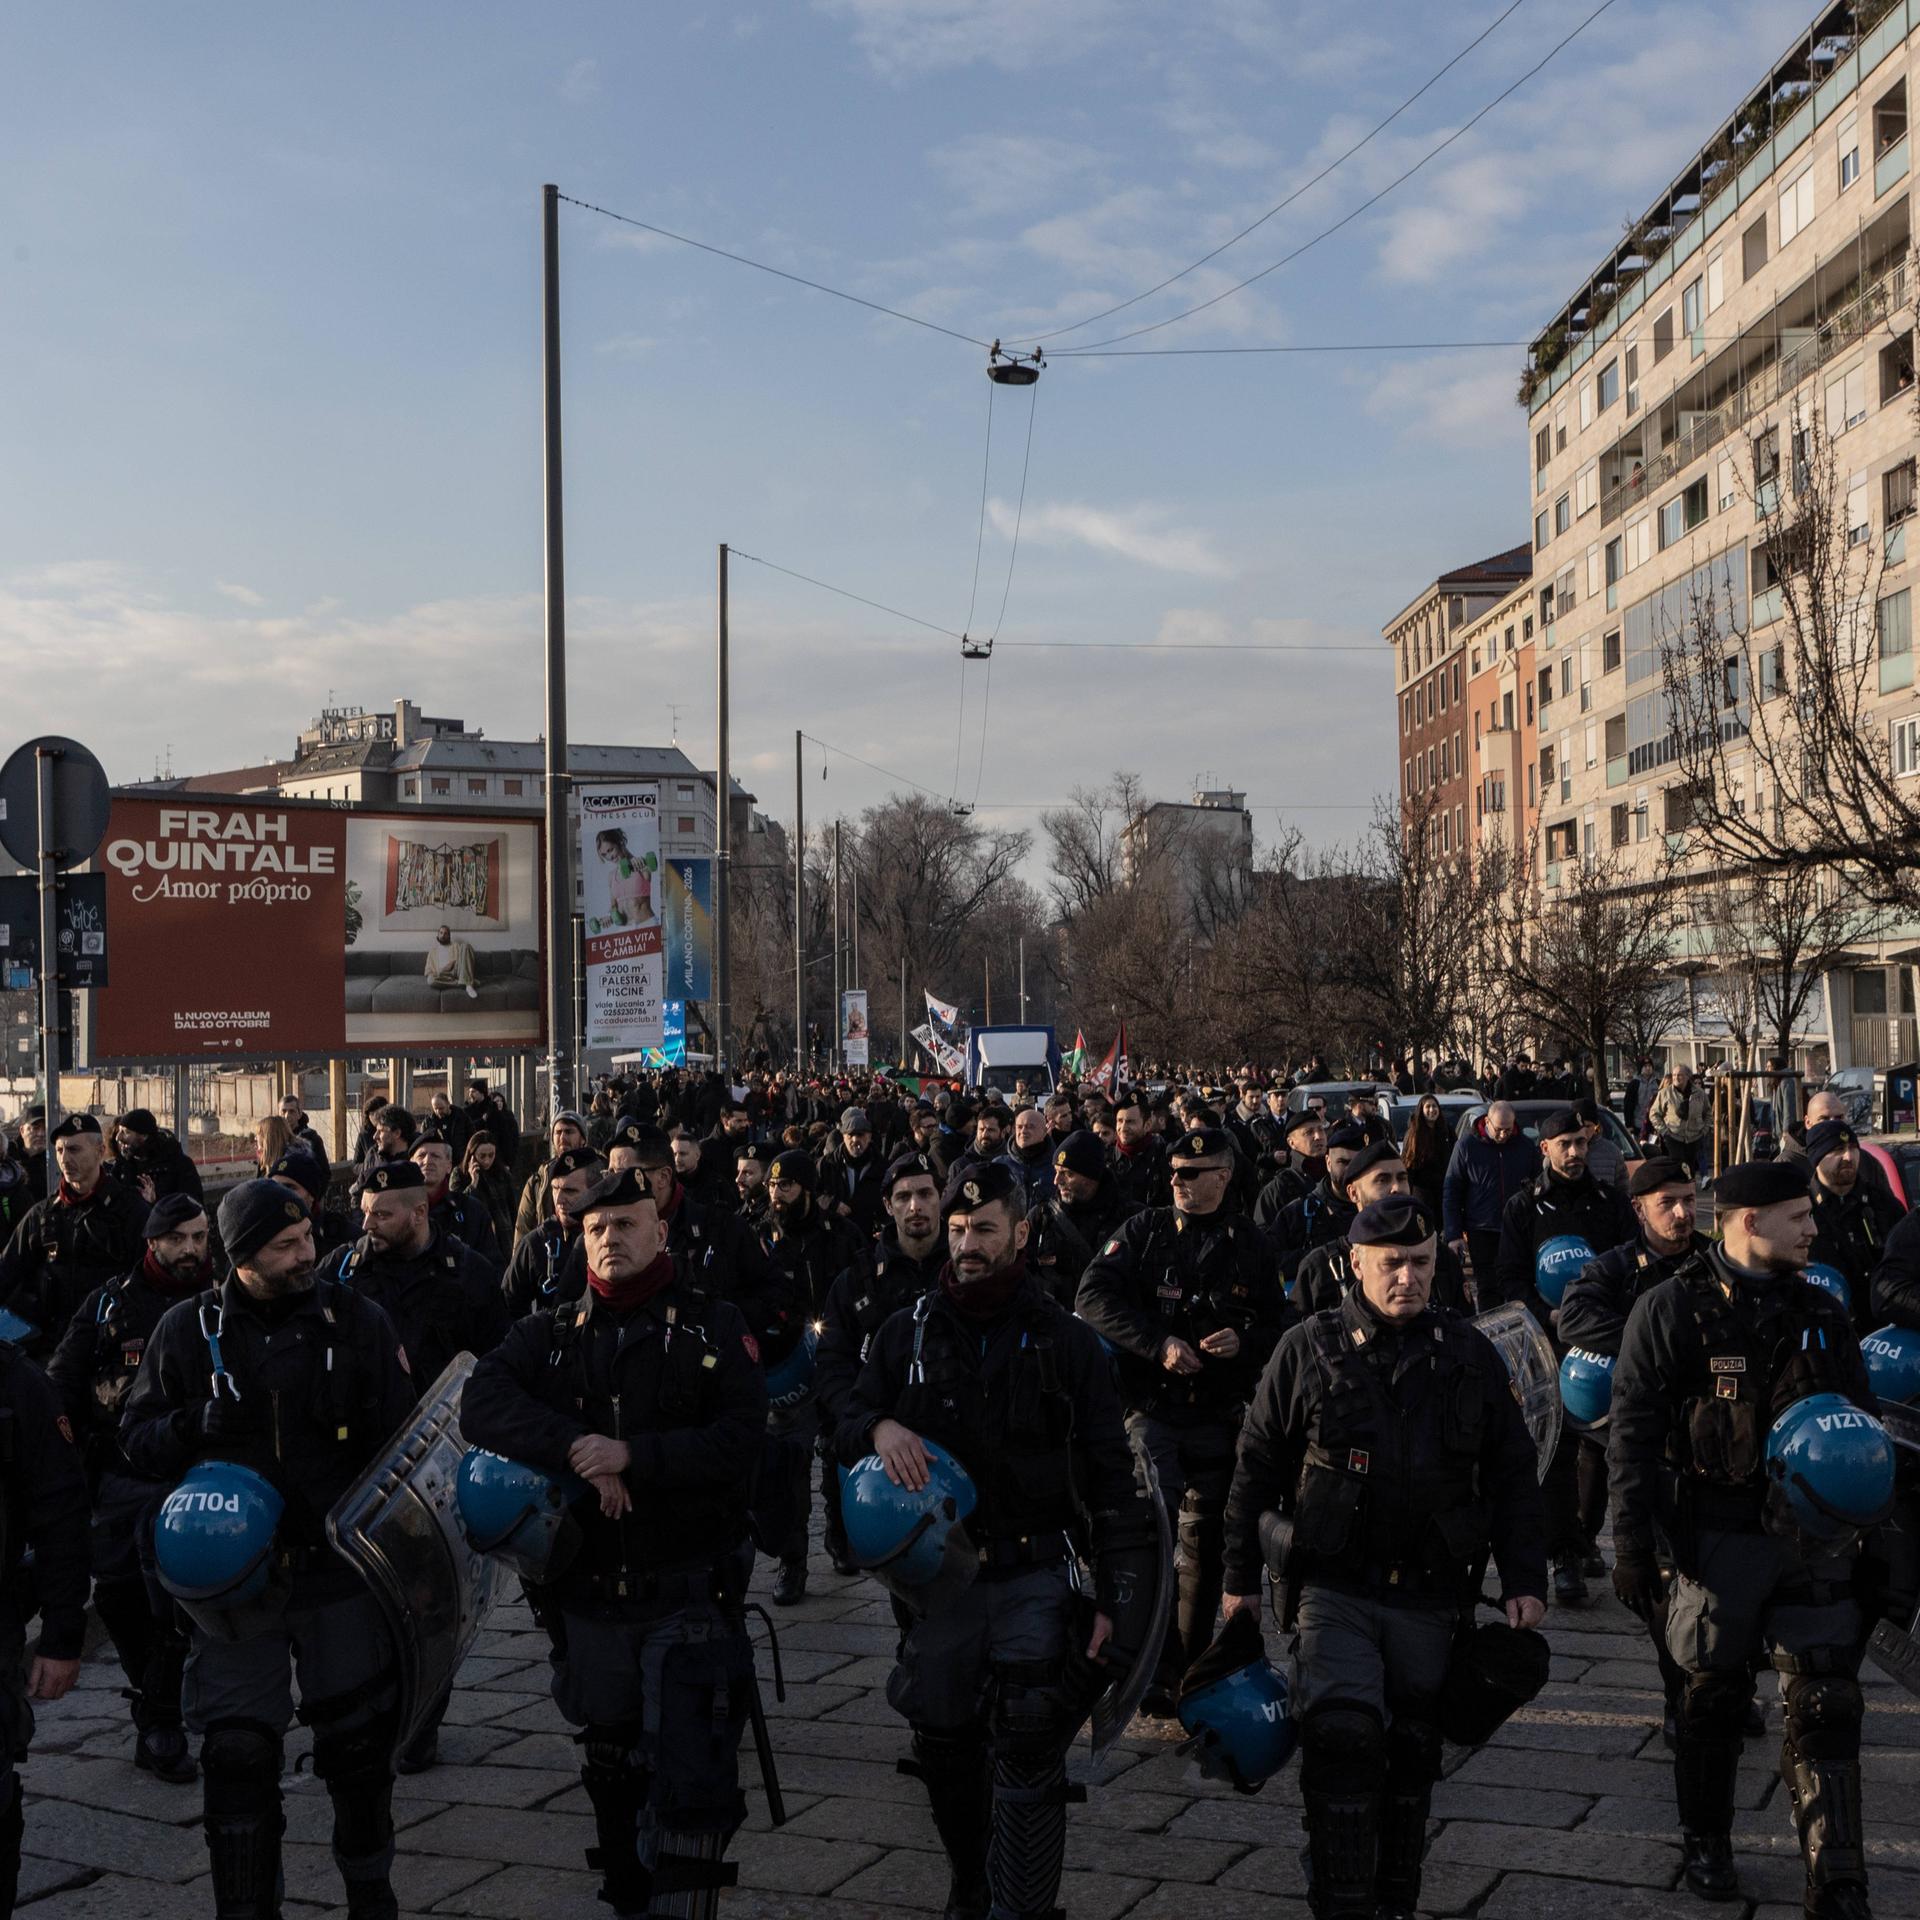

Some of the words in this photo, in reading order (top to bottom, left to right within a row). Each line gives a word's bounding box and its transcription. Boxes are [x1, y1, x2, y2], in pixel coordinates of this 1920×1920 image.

[321, 718, 393, 741] MAJOR
[160, 809, 287, 842] FRAH
[584, 812, 627, 820] FITNESS
[106, 838, 336, 877] QUINTALE
[684, 866, 693, 890] 2026
[132, 873, 222, 903] Amor
[228, 876, 312, 905] proprio
[684, 891, 693, 940] CORTINA
[591, 942, 597, 951] E
[600, 941, 611, 950] LA
[614, 936, 632, 947] TUA
[634, 931, 656, 943] VITA
[605, 964, 628, 974] 3200
[684, 941, 694, 990] MILANO
[602, 975, 648, 986] PALESTRA
[606, 987, 644, 997] PISCINE
[595, 1000, 613, 1009] viale
[615, 999, 645, 1008] Lucania
[174, 1012, 183, 1020] IL
[185, 1011, 228, 1020] NUOVO
[229, 1011, 271, 1019] ALBUM
[175, 1021, 198, 1029] DAL
[200, 1020, 214, 1029] 10
[215, 1019, 271, 1028] OTTOBRE
[1900, 1079, 1912, 1098] P
[1713, 1359, 1743, 1369] POLIZIA
